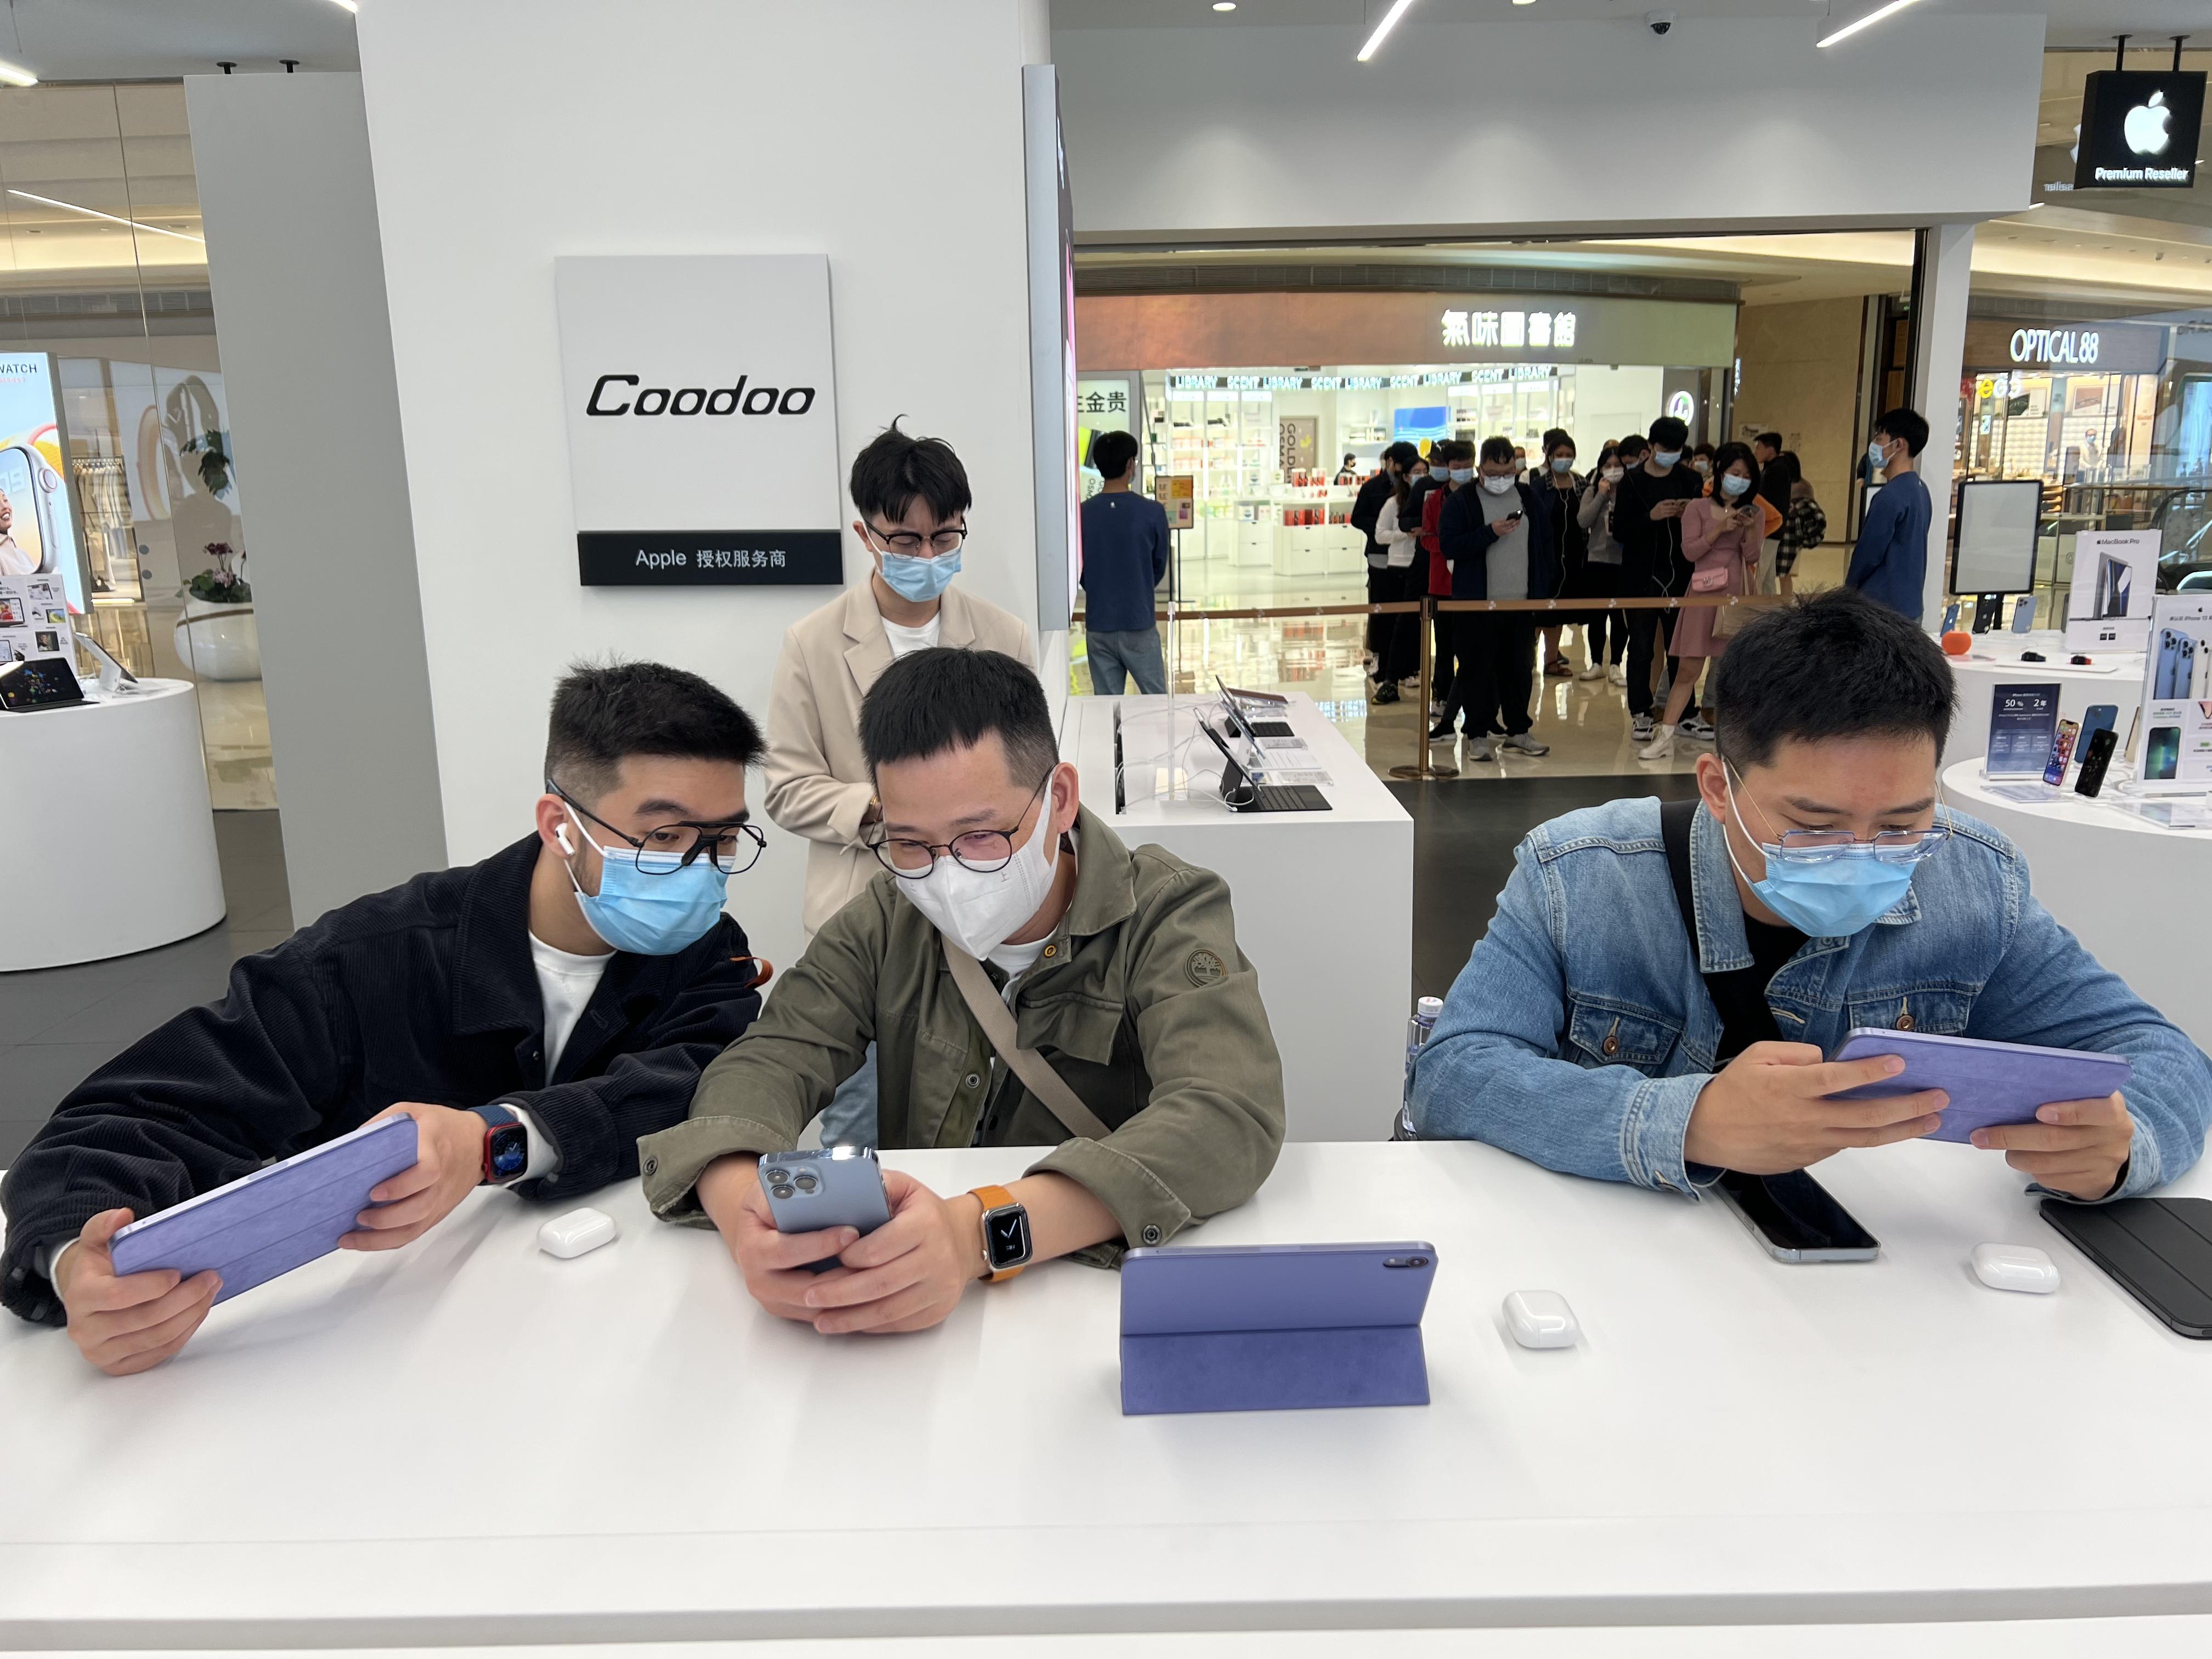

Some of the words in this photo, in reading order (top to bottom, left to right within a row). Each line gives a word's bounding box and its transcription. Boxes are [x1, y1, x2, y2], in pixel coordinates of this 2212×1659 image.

[2095, 167, 2143, 180] Premium
[2145, 167, 2189, 180] Reseller
[2010, 329, 2078, 363] OPTICAL
[2079, 331, 2099, 363] 88
[1471, 368, 1504, 382] SCENT
[1509, 365, 1552, 381] LIBRARY
[586, 375, 815, 415] Coodoo
[635, 549, 686, 569] Apple
[696, 550, 786, 568] 授权服务商
[2005, 699, 2016, 707] 50
